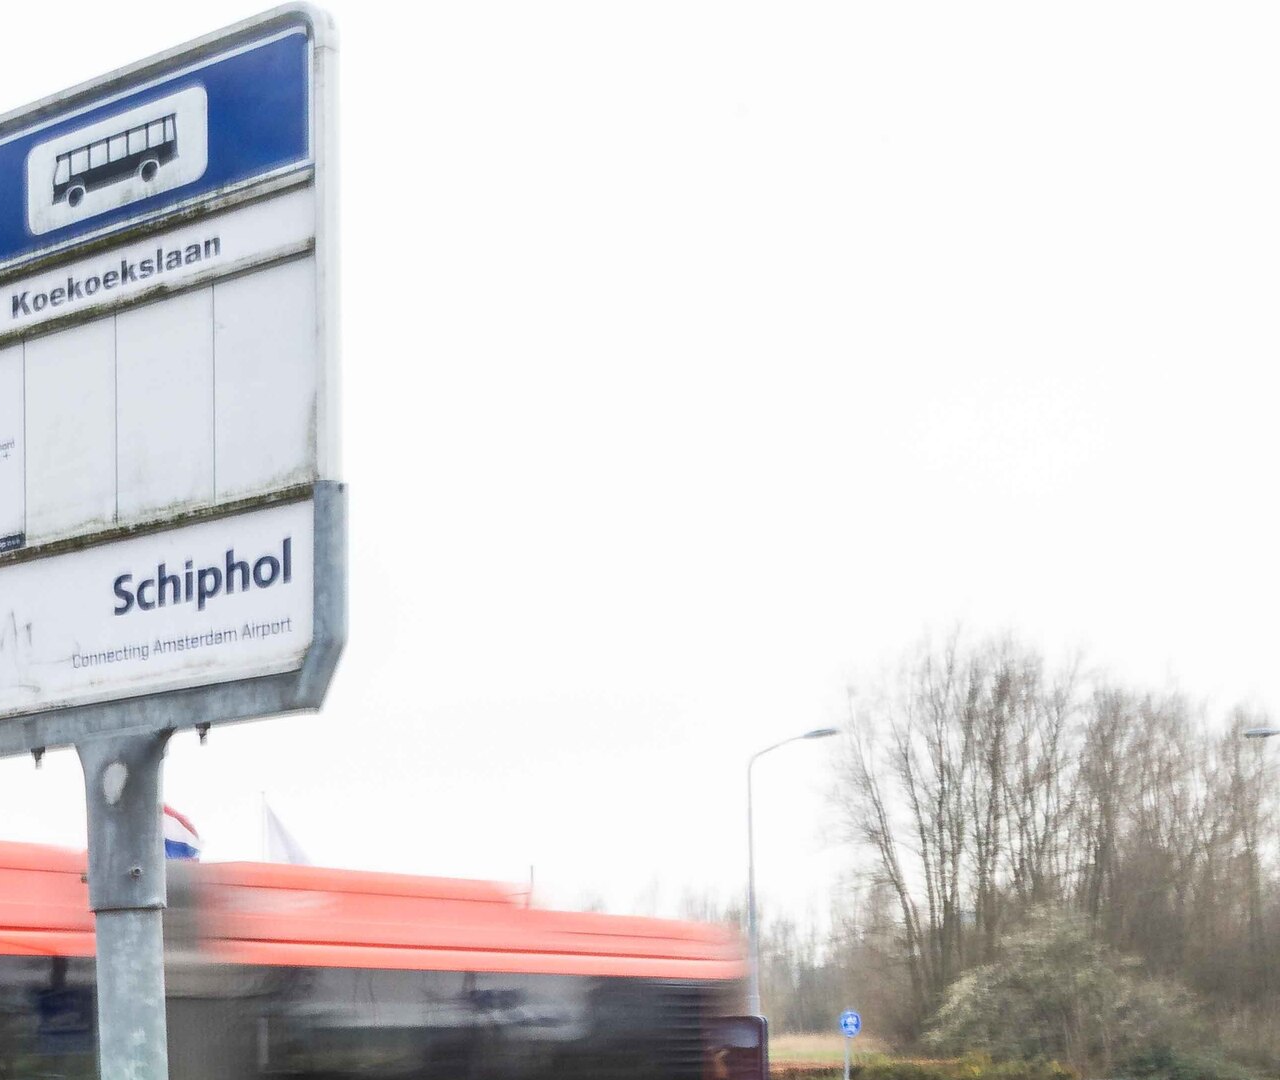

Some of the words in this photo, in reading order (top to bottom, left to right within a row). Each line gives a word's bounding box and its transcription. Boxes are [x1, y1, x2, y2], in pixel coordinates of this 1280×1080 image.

[11, 236, 221, 319] Koekoekslaan
[113, 537, 292, 616] Schiphol
[72, 642, 150, 669] Connecting
[153, 628, 238, 653] Amsterdam
[241, 618, 292, 641] Airport
